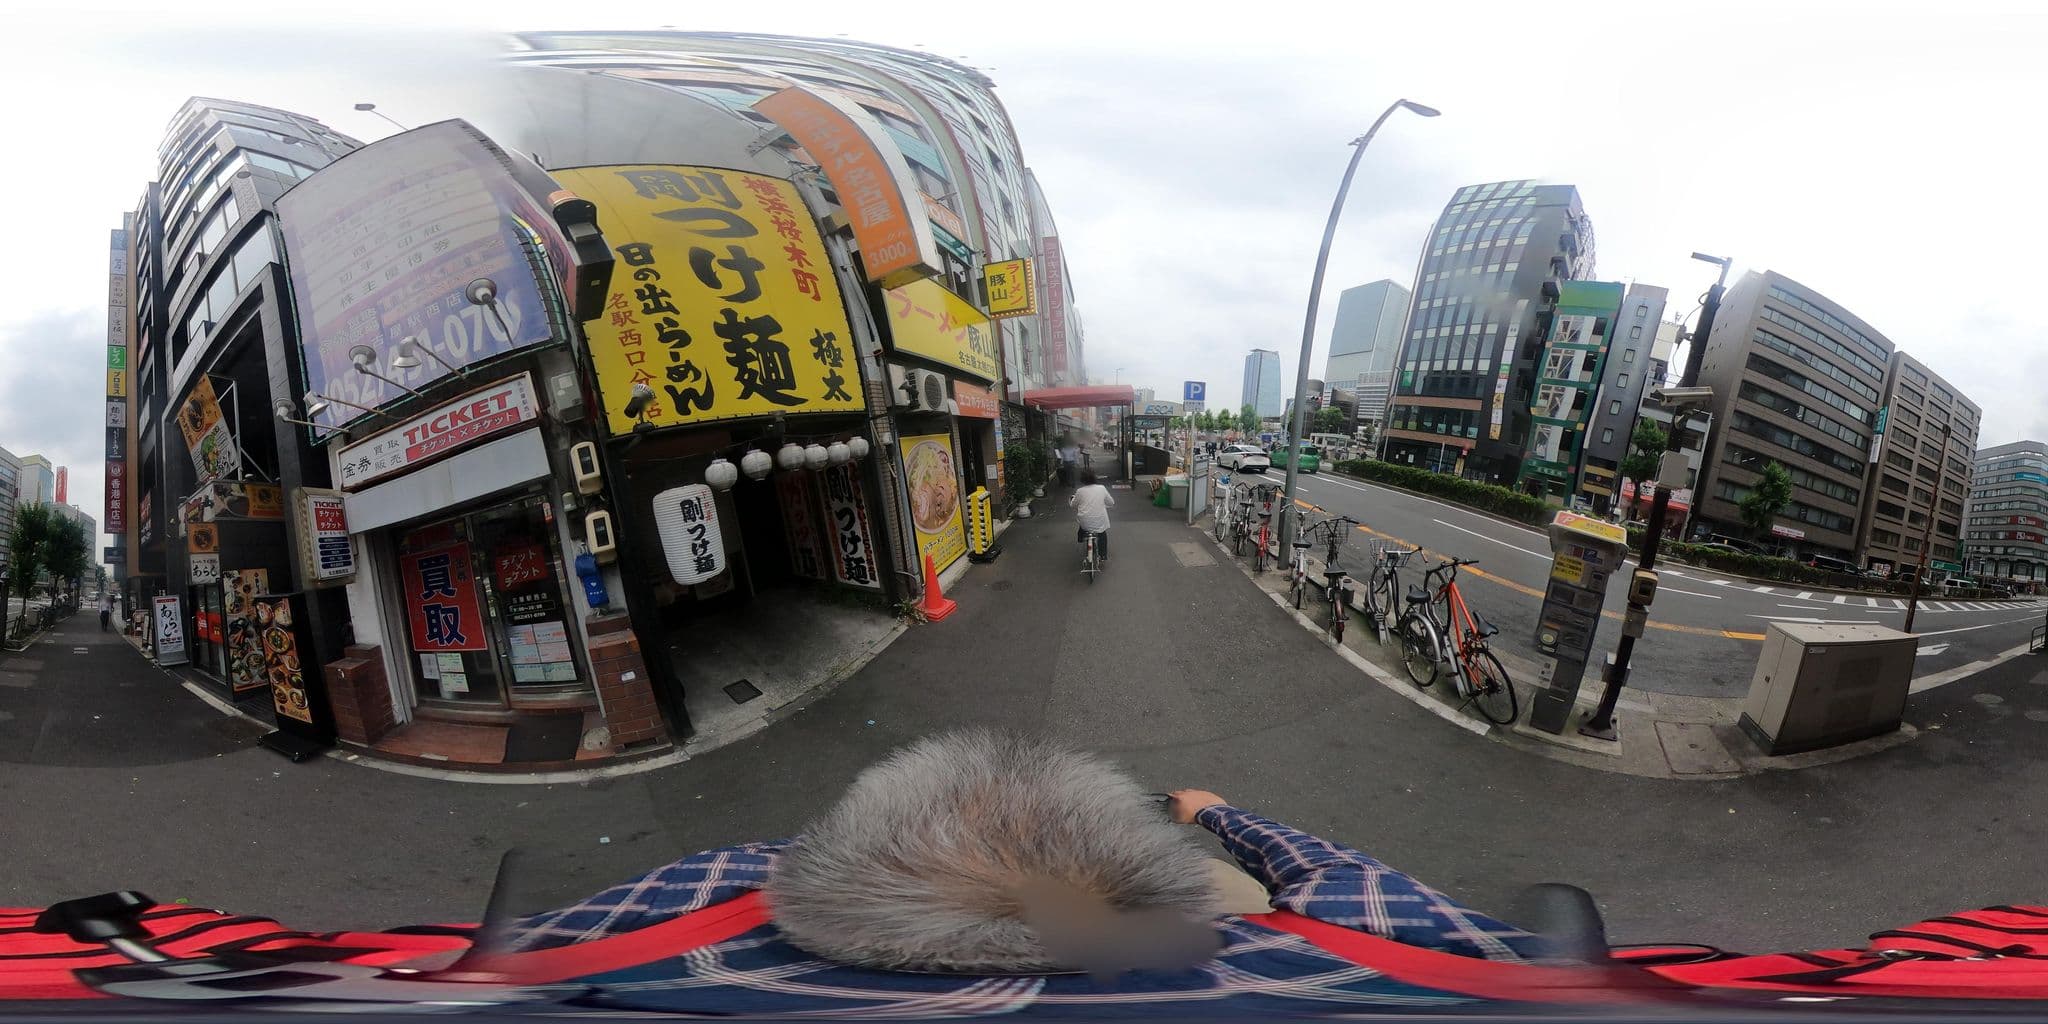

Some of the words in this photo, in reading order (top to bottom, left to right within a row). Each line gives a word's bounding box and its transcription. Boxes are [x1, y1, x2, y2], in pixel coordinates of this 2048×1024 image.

[741, 176, 821, 302] 横浜桜木町
[613, 170, 809, 406] 剛つけ麺
[989, 273, 1008, 301] 豚山
[1006, 263, 1022, 305] ラーメン
[615, 242, 715, 416] 日の出らーめん
[888, 288, 968, 343] ラーメン
[967, 322, 995, 361] 豚山
[809, 328, 852, 402] 極太
[1144, 403, 1174, 414] ESCA
[1190, 383, 1202, 399] P
[403, 390, 513, 445] TICKET
[343, 456, 372, 479] 金券
[373, 440, 399, 457] 買取
[374, 455, 402, 471] 販売
[111, 479, 121, 520] 香港飯店
[680, 496, 717, 575] 剛つけ麺
[192, 565, 218, 577] あらし
[160, 604, 178, 637] あらし
[417, 554, 467, 646] 買取
